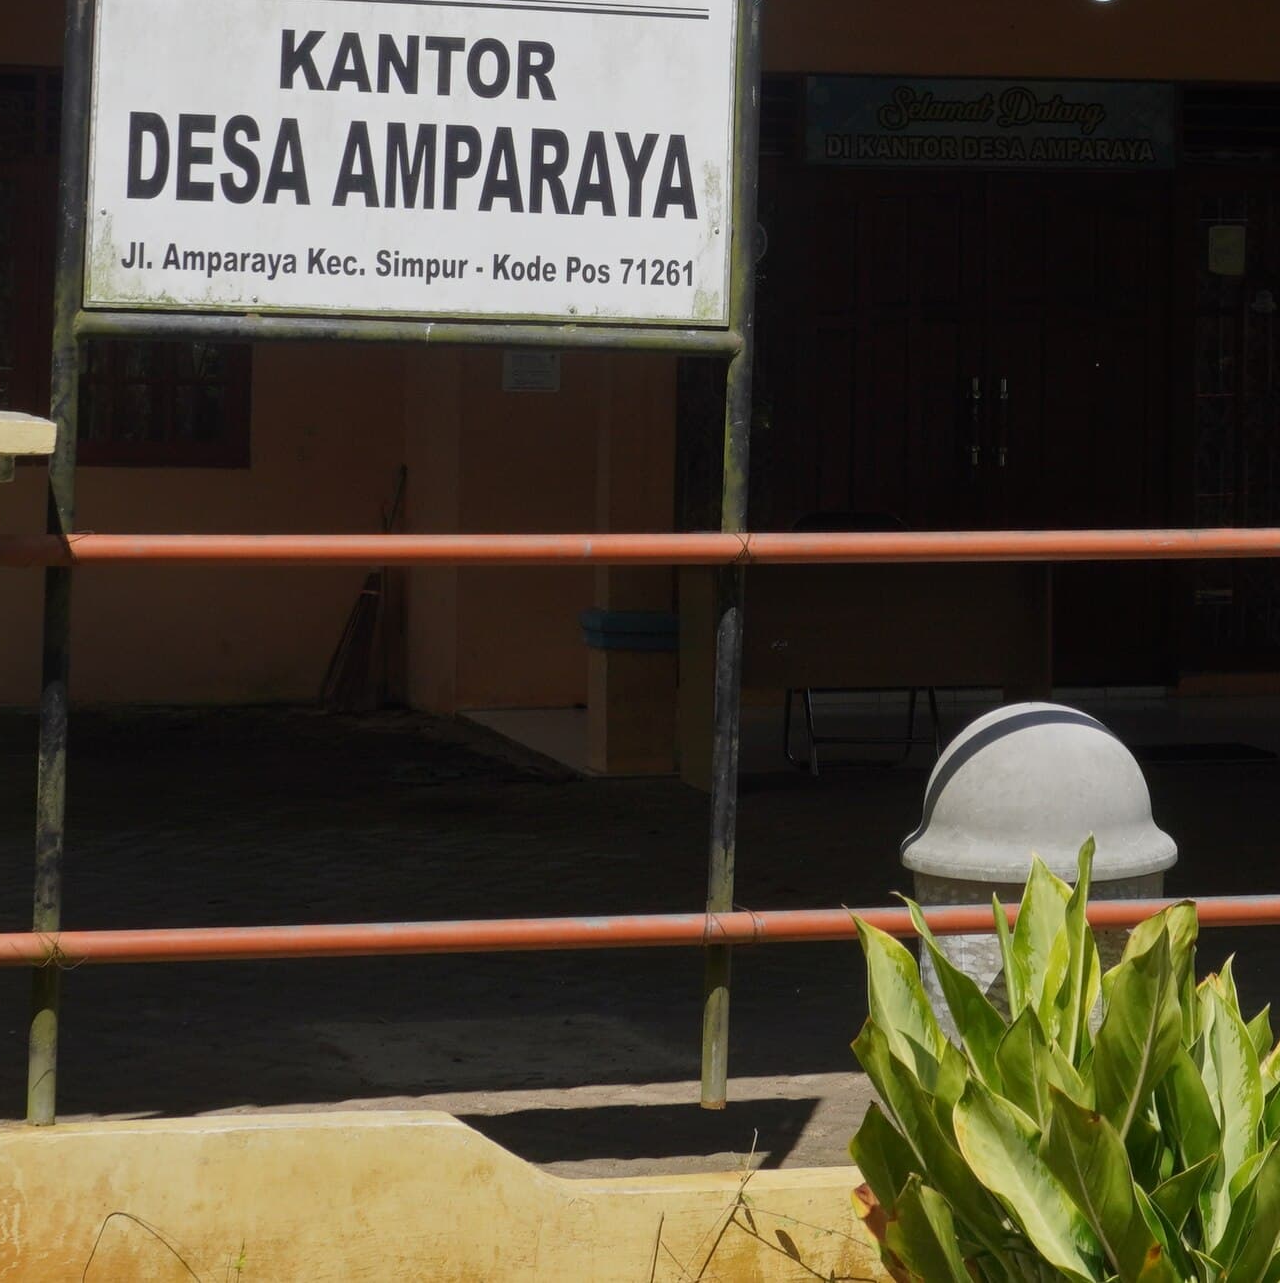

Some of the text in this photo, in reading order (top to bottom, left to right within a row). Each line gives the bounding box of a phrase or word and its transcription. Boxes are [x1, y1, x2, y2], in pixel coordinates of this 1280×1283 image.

[279, 29, 557, 101] KANTOR
[879, 86, 1105, 134] Selamat Datang
[126, 111, 698, 220] DESA AMPARAYA
[825, 135, 1155, 162] DI KANTOR DESA AMPARAYA
[120, 241, 153, 270] Jl.
[162, 243, 297, 281] Amparaya
[307, 247, 365, 276] Kec.
[375, 249, 469, 285] Simpur
[492, 253, 557, 282] Kode
[566, 256, 610, 284] Pos
[619, 258, 693, 287] 71261
